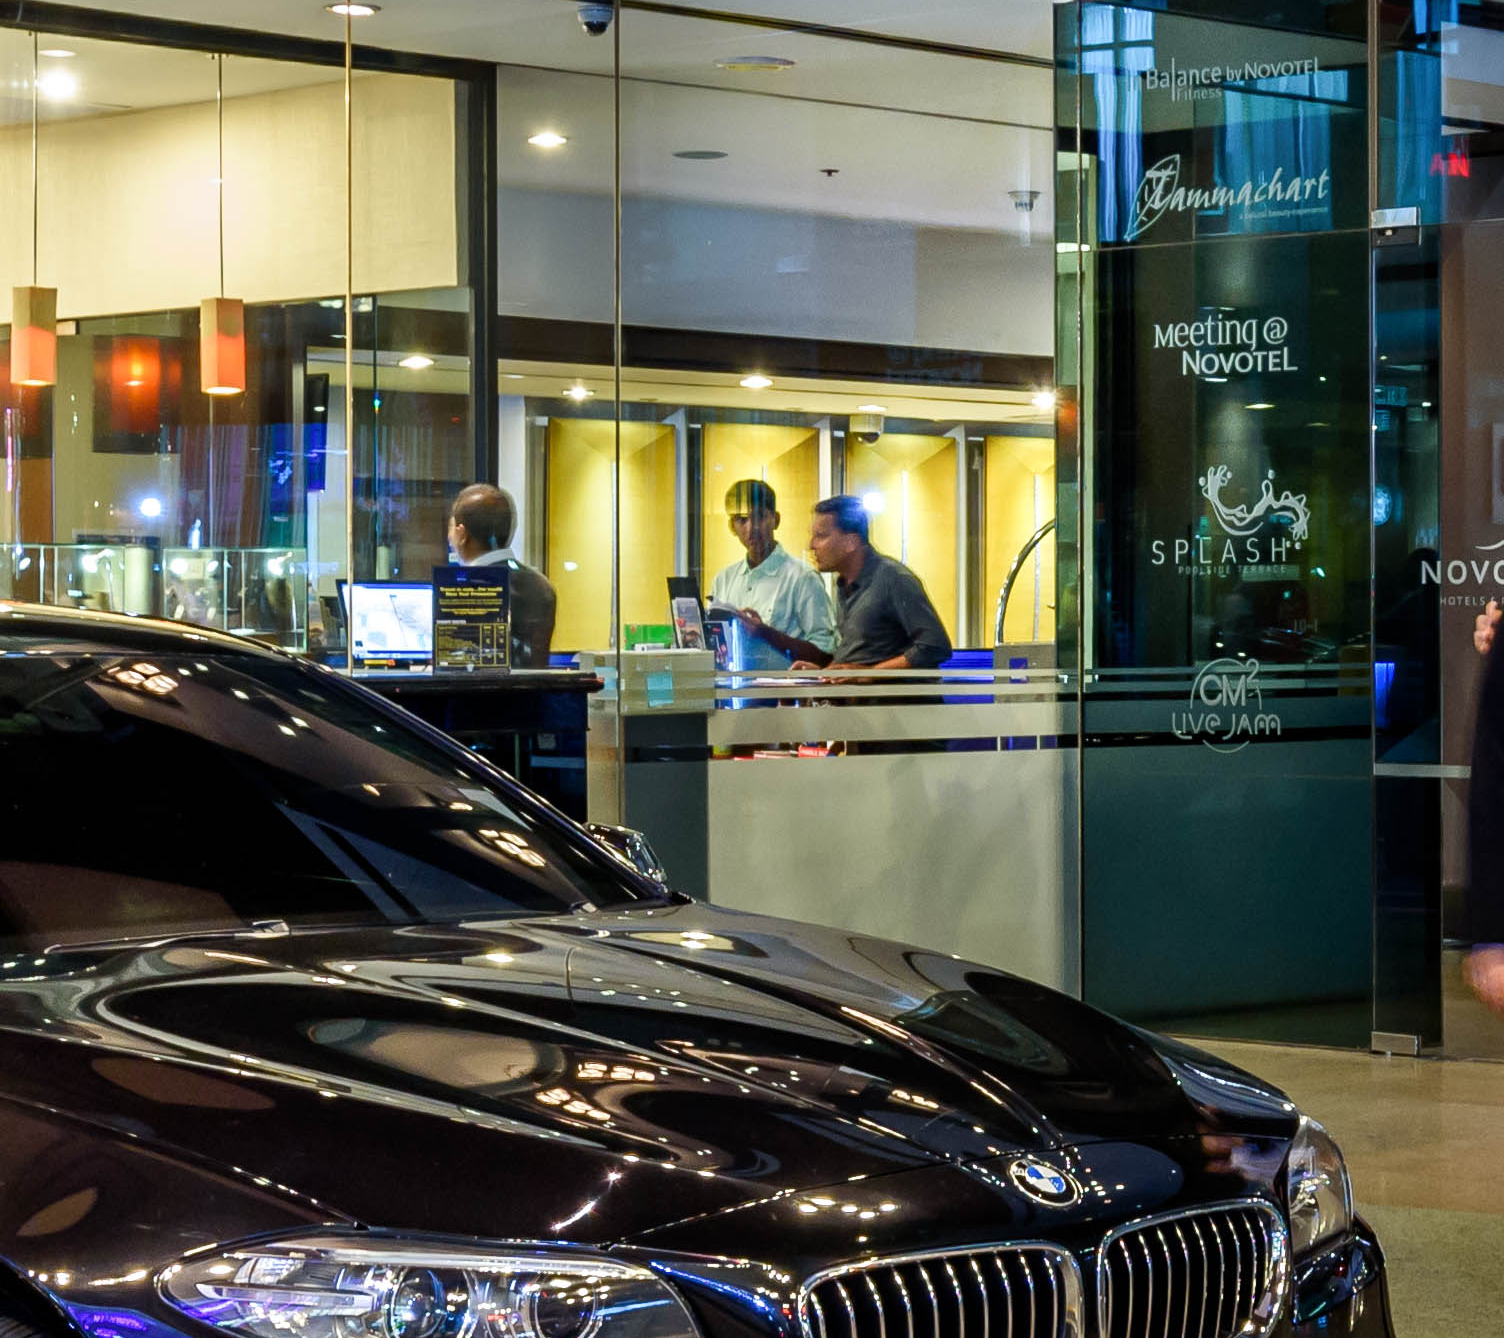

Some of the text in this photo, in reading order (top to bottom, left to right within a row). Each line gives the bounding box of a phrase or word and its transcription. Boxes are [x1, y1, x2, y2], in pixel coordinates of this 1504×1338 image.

[1146, 57, 1319, 95] Balance by NOVOTEL
[1176, 86, 1223, 102] Fitness
[1153, 313, 1288, 352] Meeting @
[1182, 347, 1299, 376] NOVOTEL
[1151, 537, 1287, 565] SPLASH
[1238, 564, 1287, 575] TERRACE
[1440, 596, 1486, 606] HOTELS
